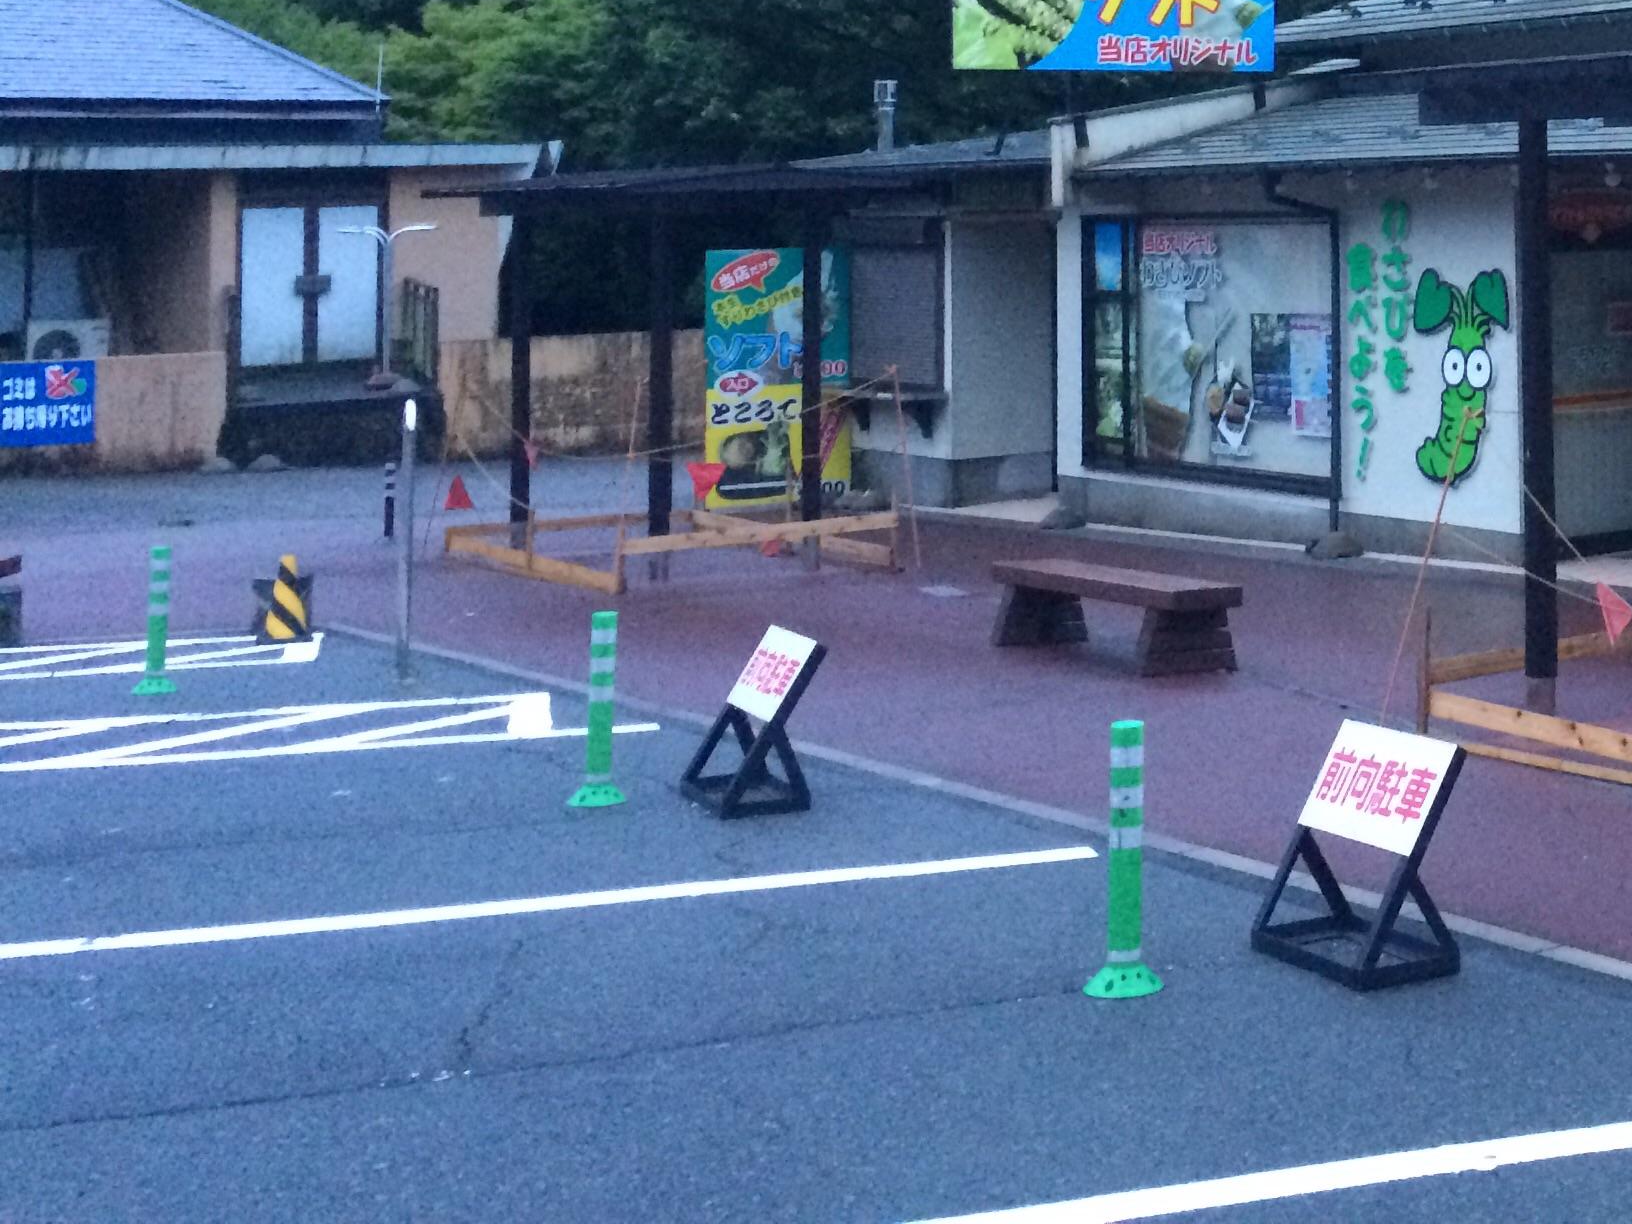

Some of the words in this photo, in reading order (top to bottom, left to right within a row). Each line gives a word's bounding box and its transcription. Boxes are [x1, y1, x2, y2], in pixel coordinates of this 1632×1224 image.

[1097, 34, 1259, 66] 当店オリジナル
[1381, 198, 1409, 393] わさびを
[707, 330, 803, 373] ソフト
[711, 398, 803, 425] ところて
[1315, 746, 1438, 825] 前向駐車
